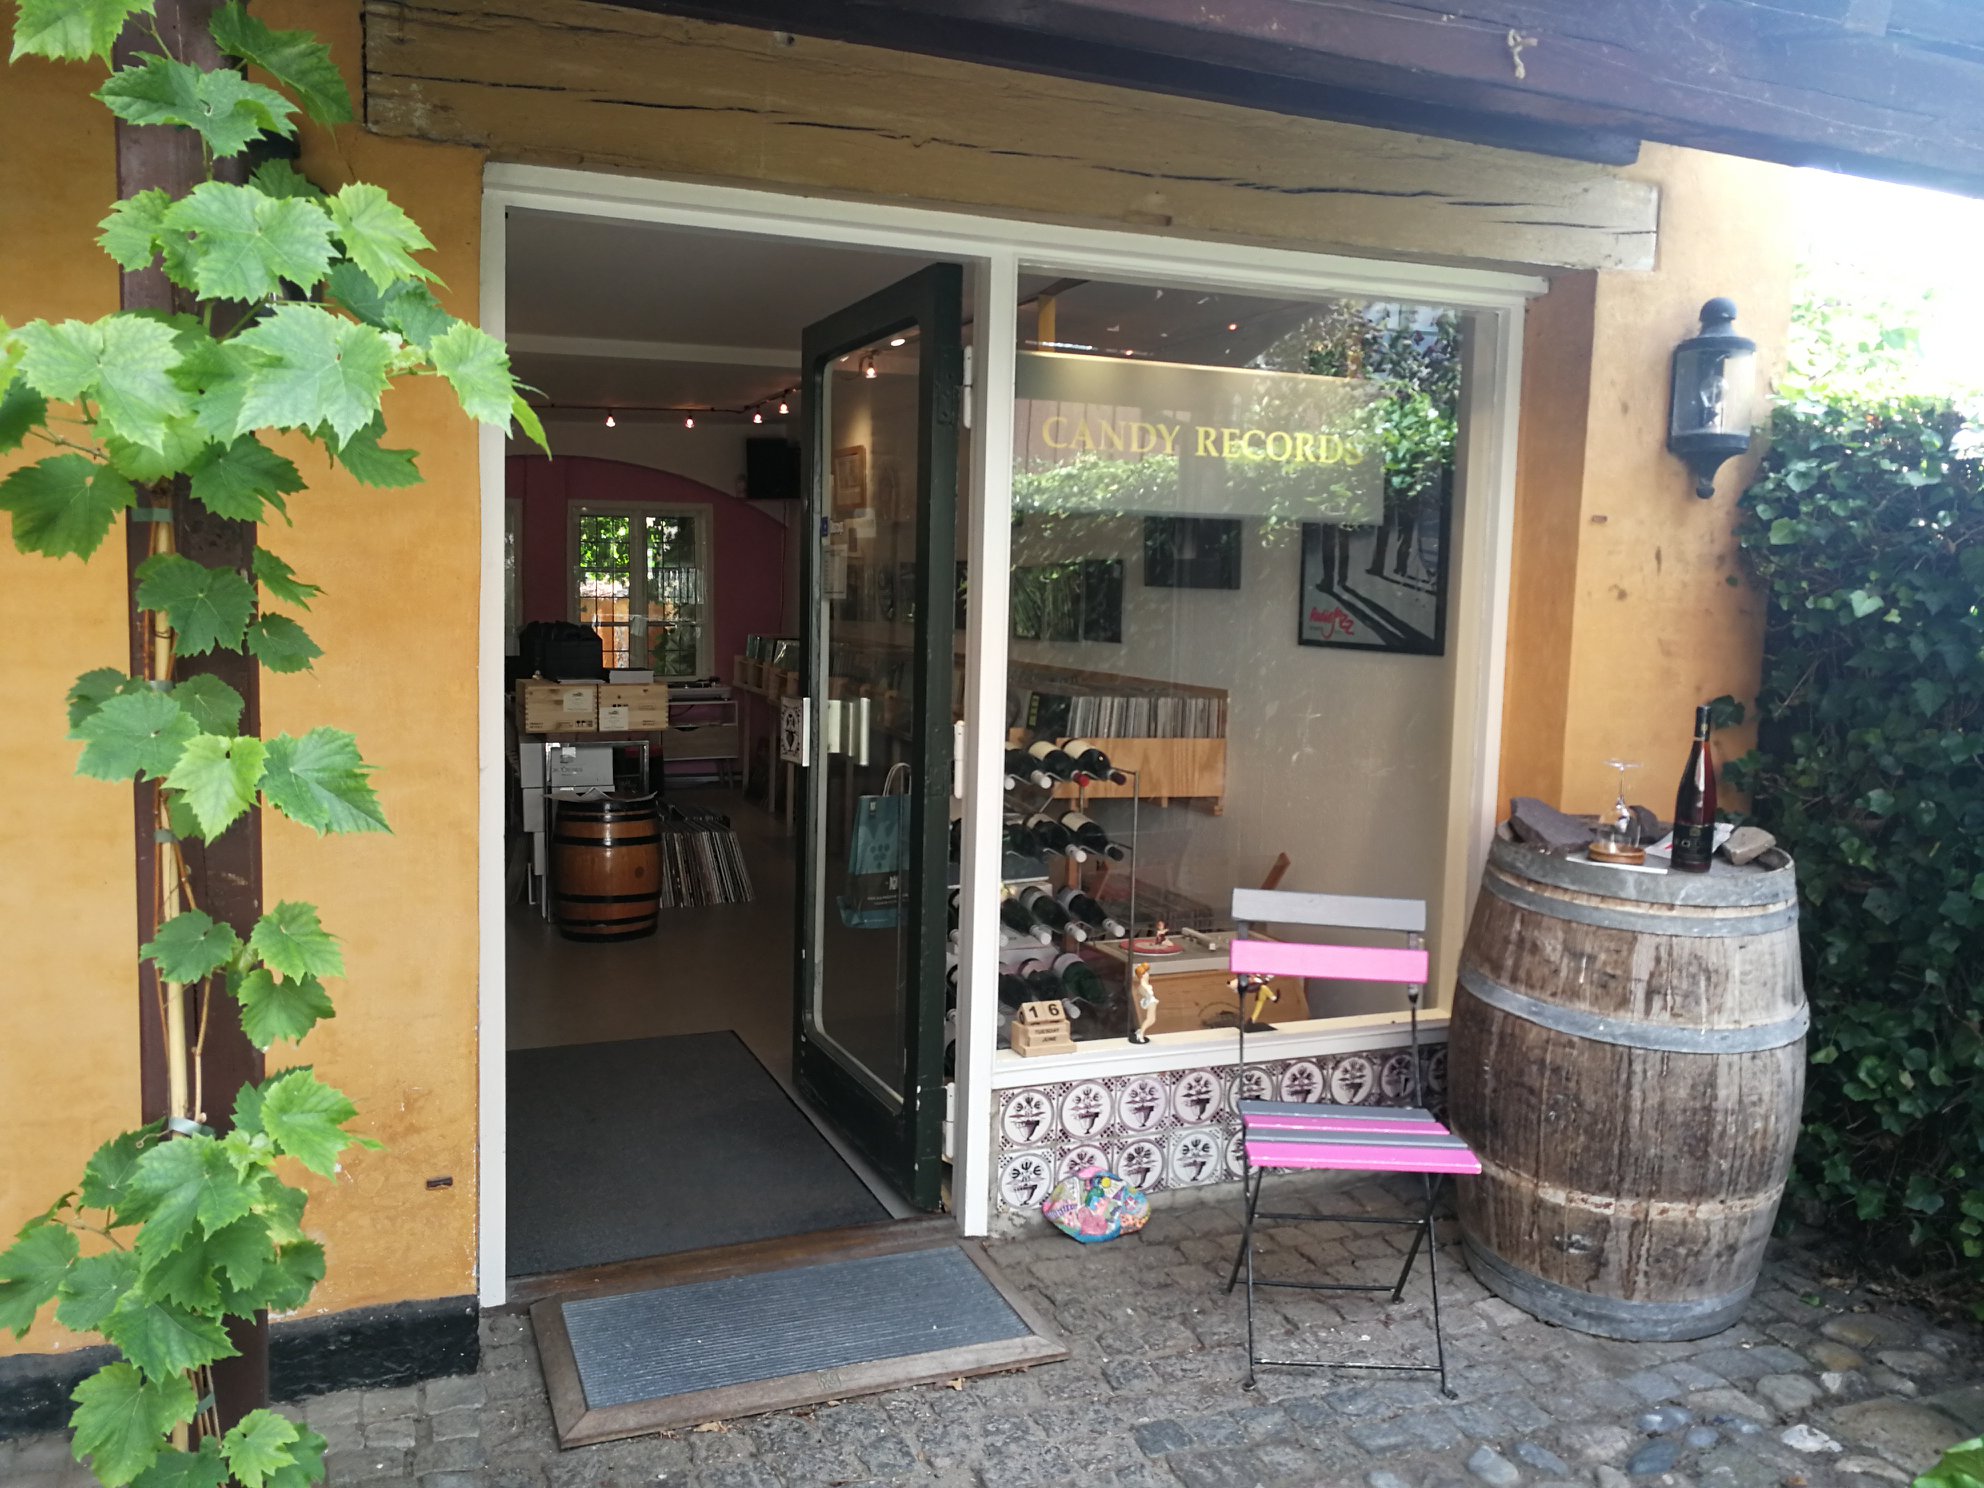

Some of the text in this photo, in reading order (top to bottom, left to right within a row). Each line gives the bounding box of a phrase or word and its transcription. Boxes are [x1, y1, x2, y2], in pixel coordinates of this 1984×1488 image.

[1042, 417, 1365, 466] CANDY RECORDS
[1035, 1027, 1060, 1035] TUESDAY
